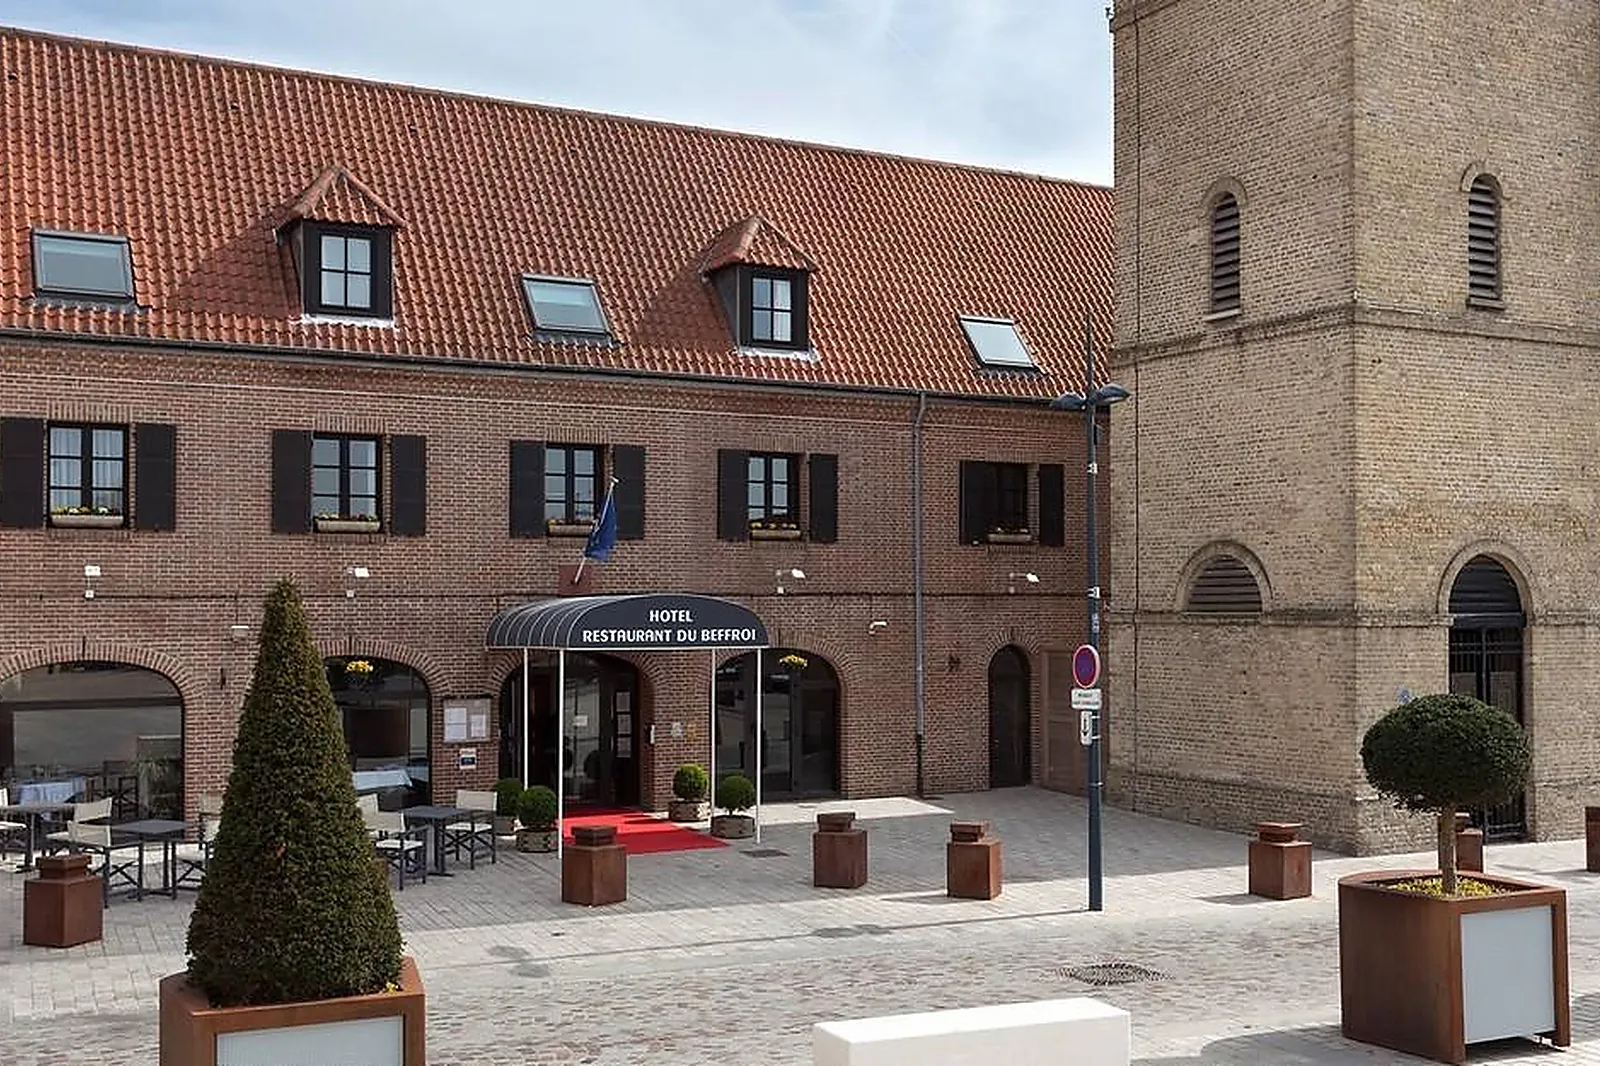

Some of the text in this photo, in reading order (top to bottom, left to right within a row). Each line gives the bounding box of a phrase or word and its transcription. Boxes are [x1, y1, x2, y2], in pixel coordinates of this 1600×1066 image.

[650, 609, 693, 622] HOTEL
[583, 628, 756, 642] RESTAURANT DU BEFFROI
